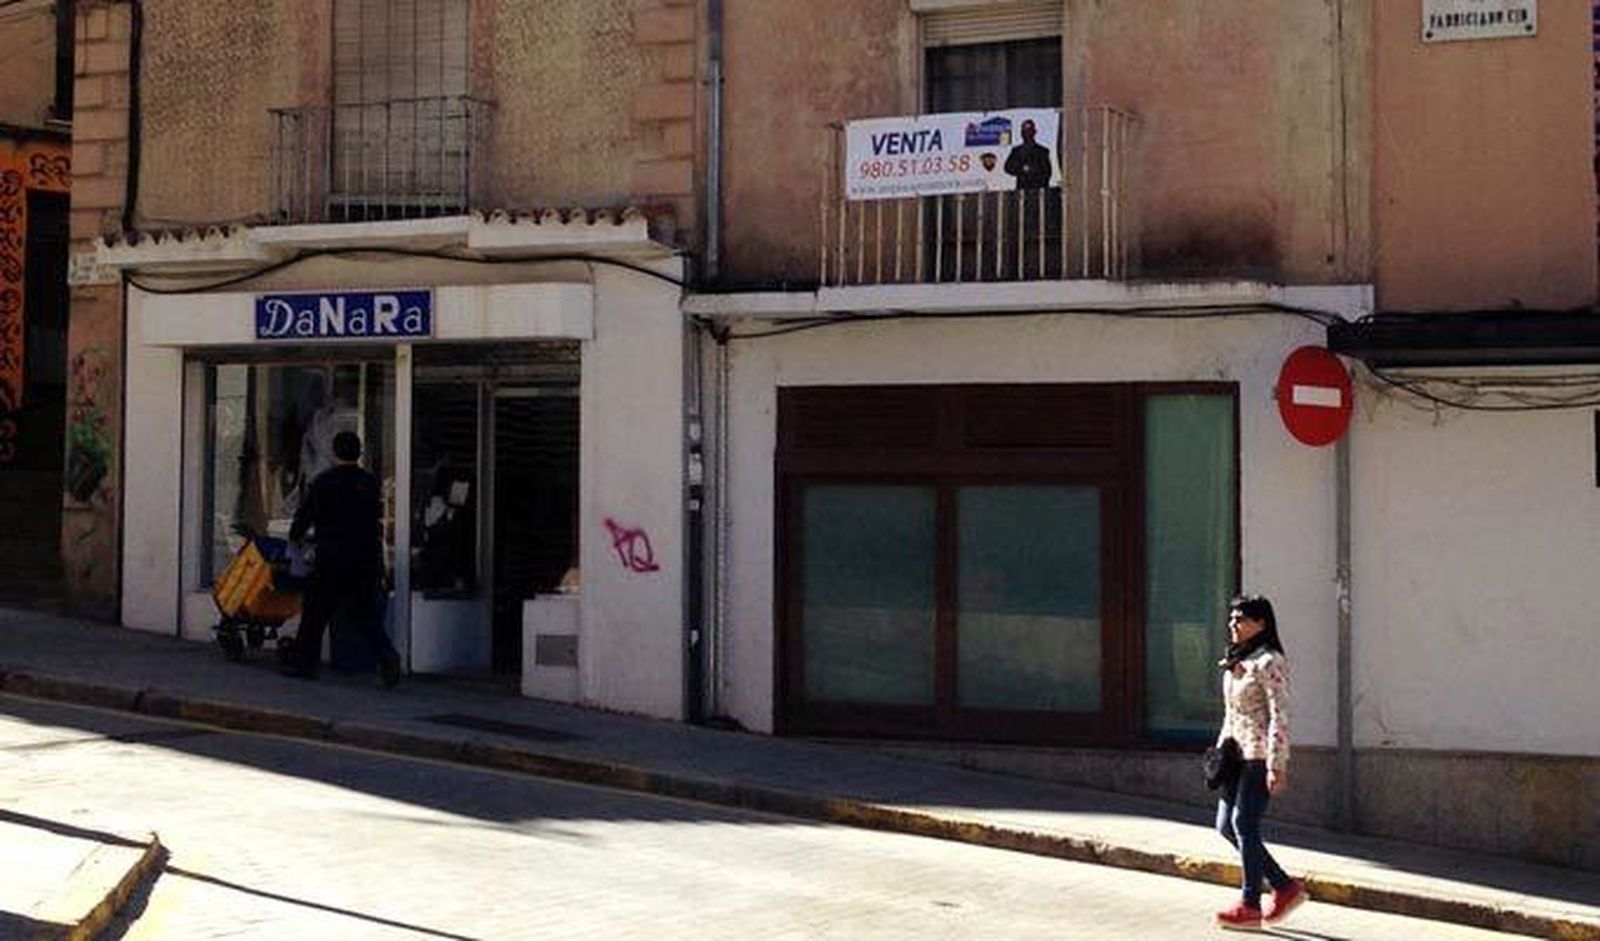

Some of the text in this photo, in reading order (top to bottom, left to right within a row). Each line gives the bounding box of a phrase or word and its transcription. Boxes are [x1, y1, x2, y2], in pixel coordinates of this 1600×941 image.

[871, 129, 943, 155] VENTA
[859, 154, 971, 179] 980.51.03.58
[259, 295, 422, 336] DaNaRa
